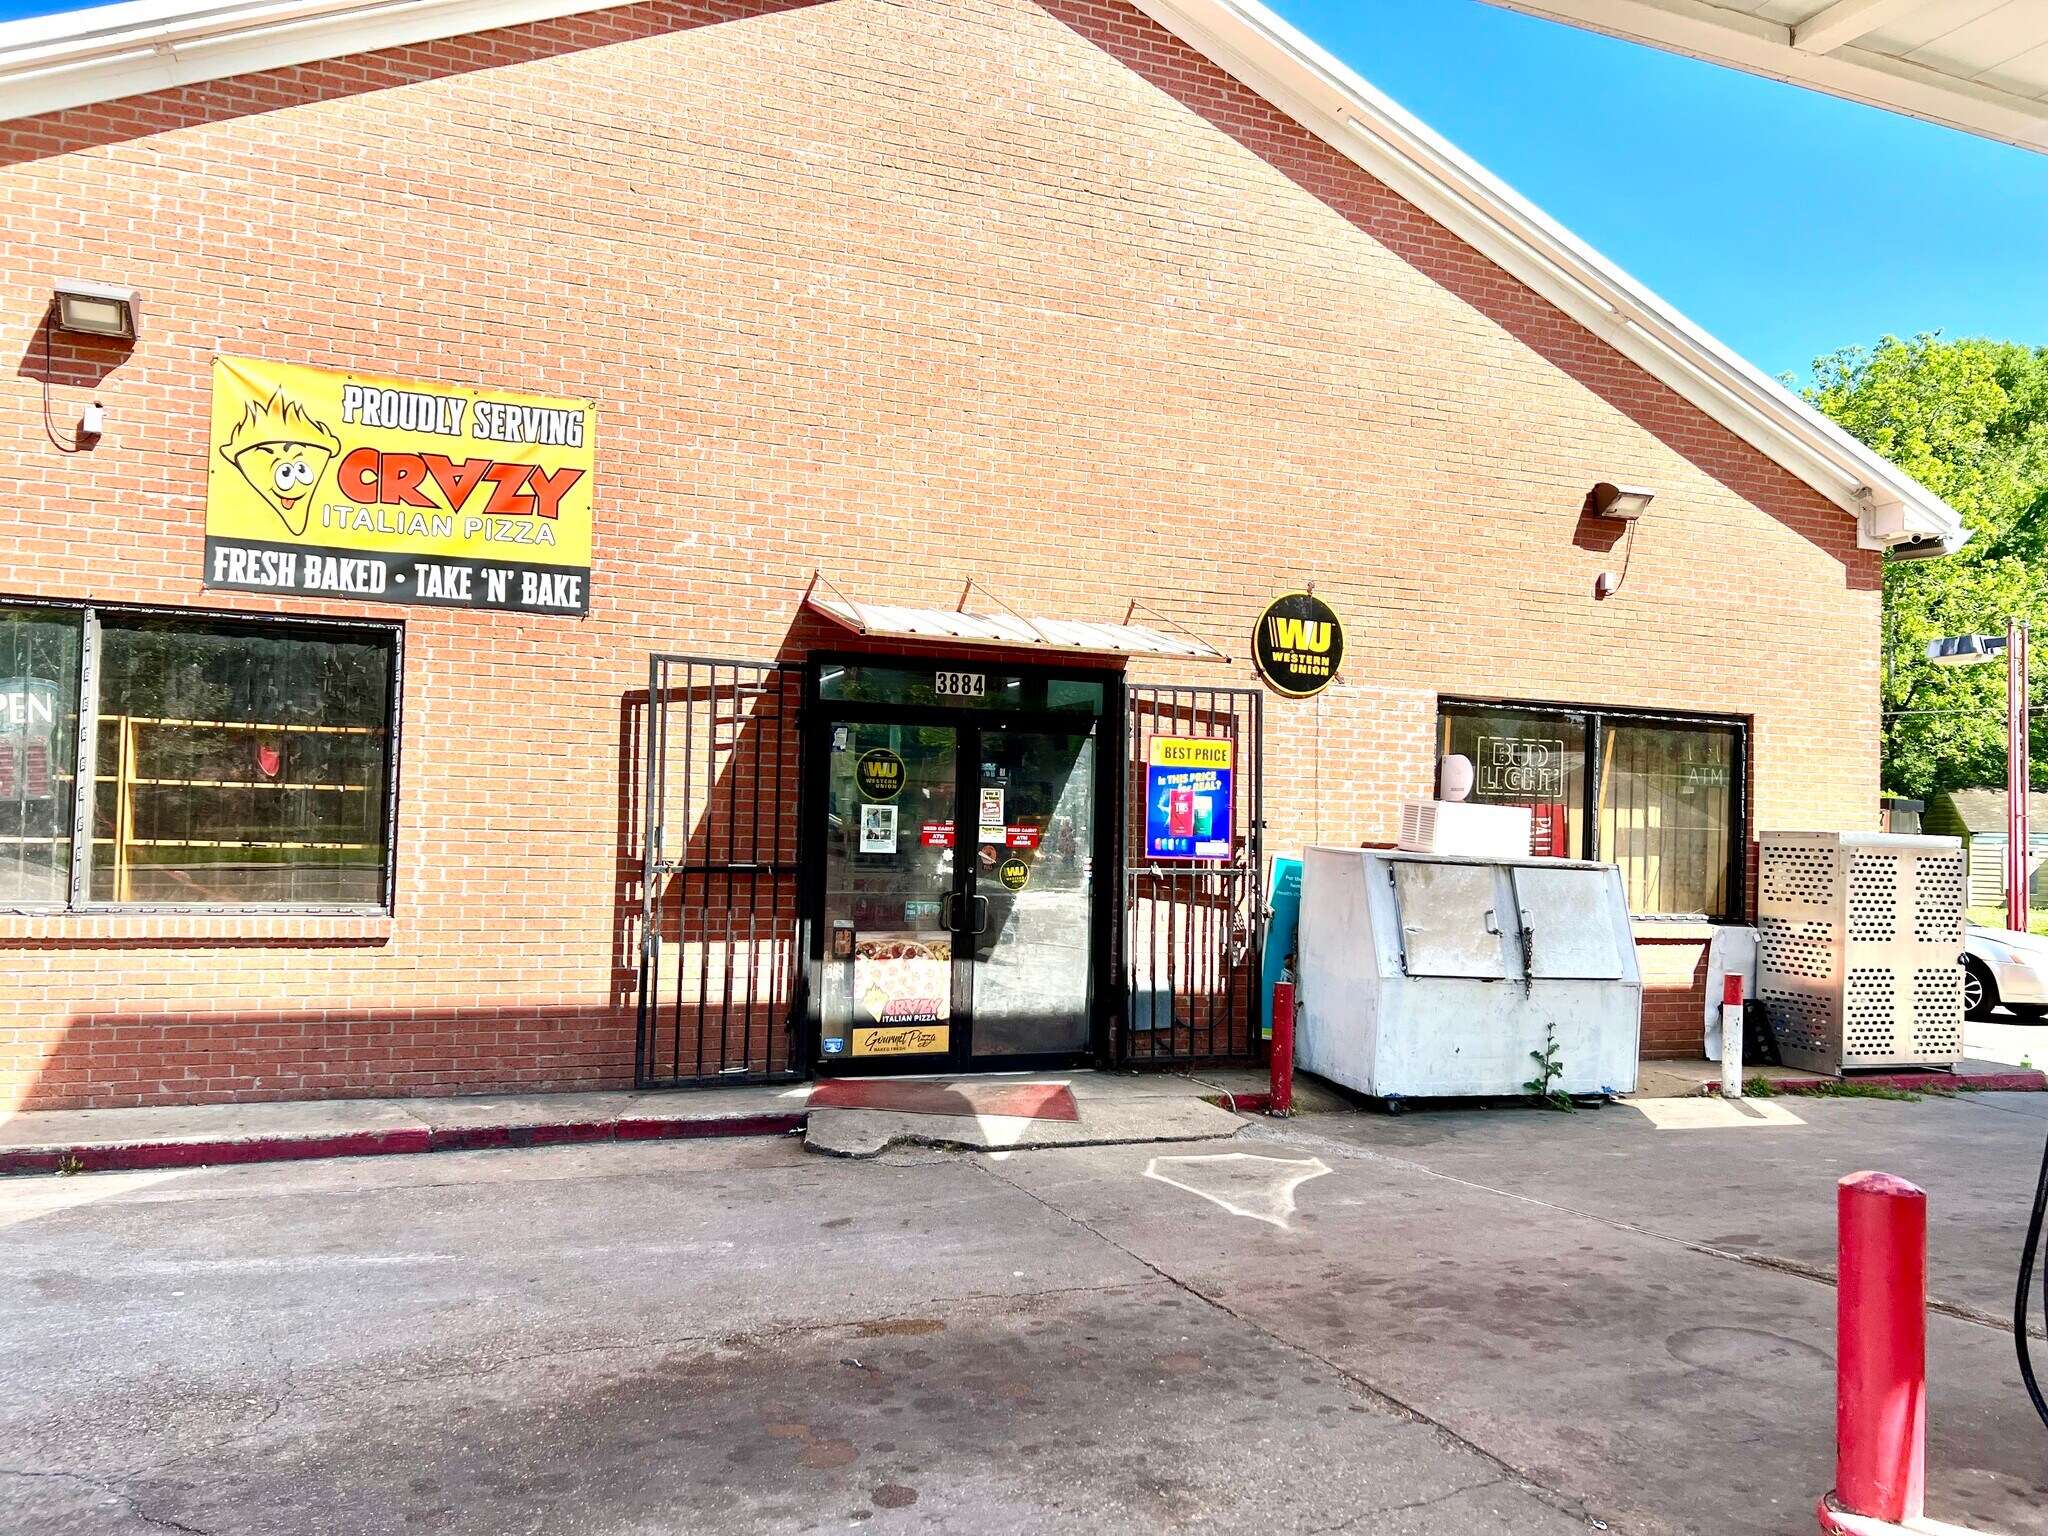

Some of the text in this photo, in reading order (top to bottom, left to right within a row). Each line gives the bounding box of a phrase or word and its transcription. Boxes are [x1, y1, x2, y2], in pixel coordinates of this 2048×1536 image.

[342, 385, 584, 448] PROUDLY SERVING
[337, 447, 587, 520] CRAZY
[322, 504, 556, 546] ITALIAN PIZZA
[213, 546, 296, 588] FRESH
[303, 554, 387, 594] BAKED
[414, 563, 473, 600] TAKE
[521, 572, 582, 608] BAKE
[1274, 617, 1332, 653] WU
[1272, 651, 1330, 666] WESTERN
[1289, 663, 1329, 676] UNION
[937, 672, 984, 695] 3884
[1165, 746, 1227, 762] BEST PRICE
[1492, 742, 1549, 766] BUD
[867, 761, 898, 777] WU
[1167, 773, 1188, 784] THIS
[1189, 771, 1217, 783] PRICE
[1480, 765, 1560, 791] LIGHT
[1689, 767, 1723, 785] ATM
[885, 998, 943, 1015] CRAZY
[882, 1015, 913, 1023] ITALIAN
[864, 1031, 909, 1051] Gourmet
[907, 1029, 936, 1047] Pizza
